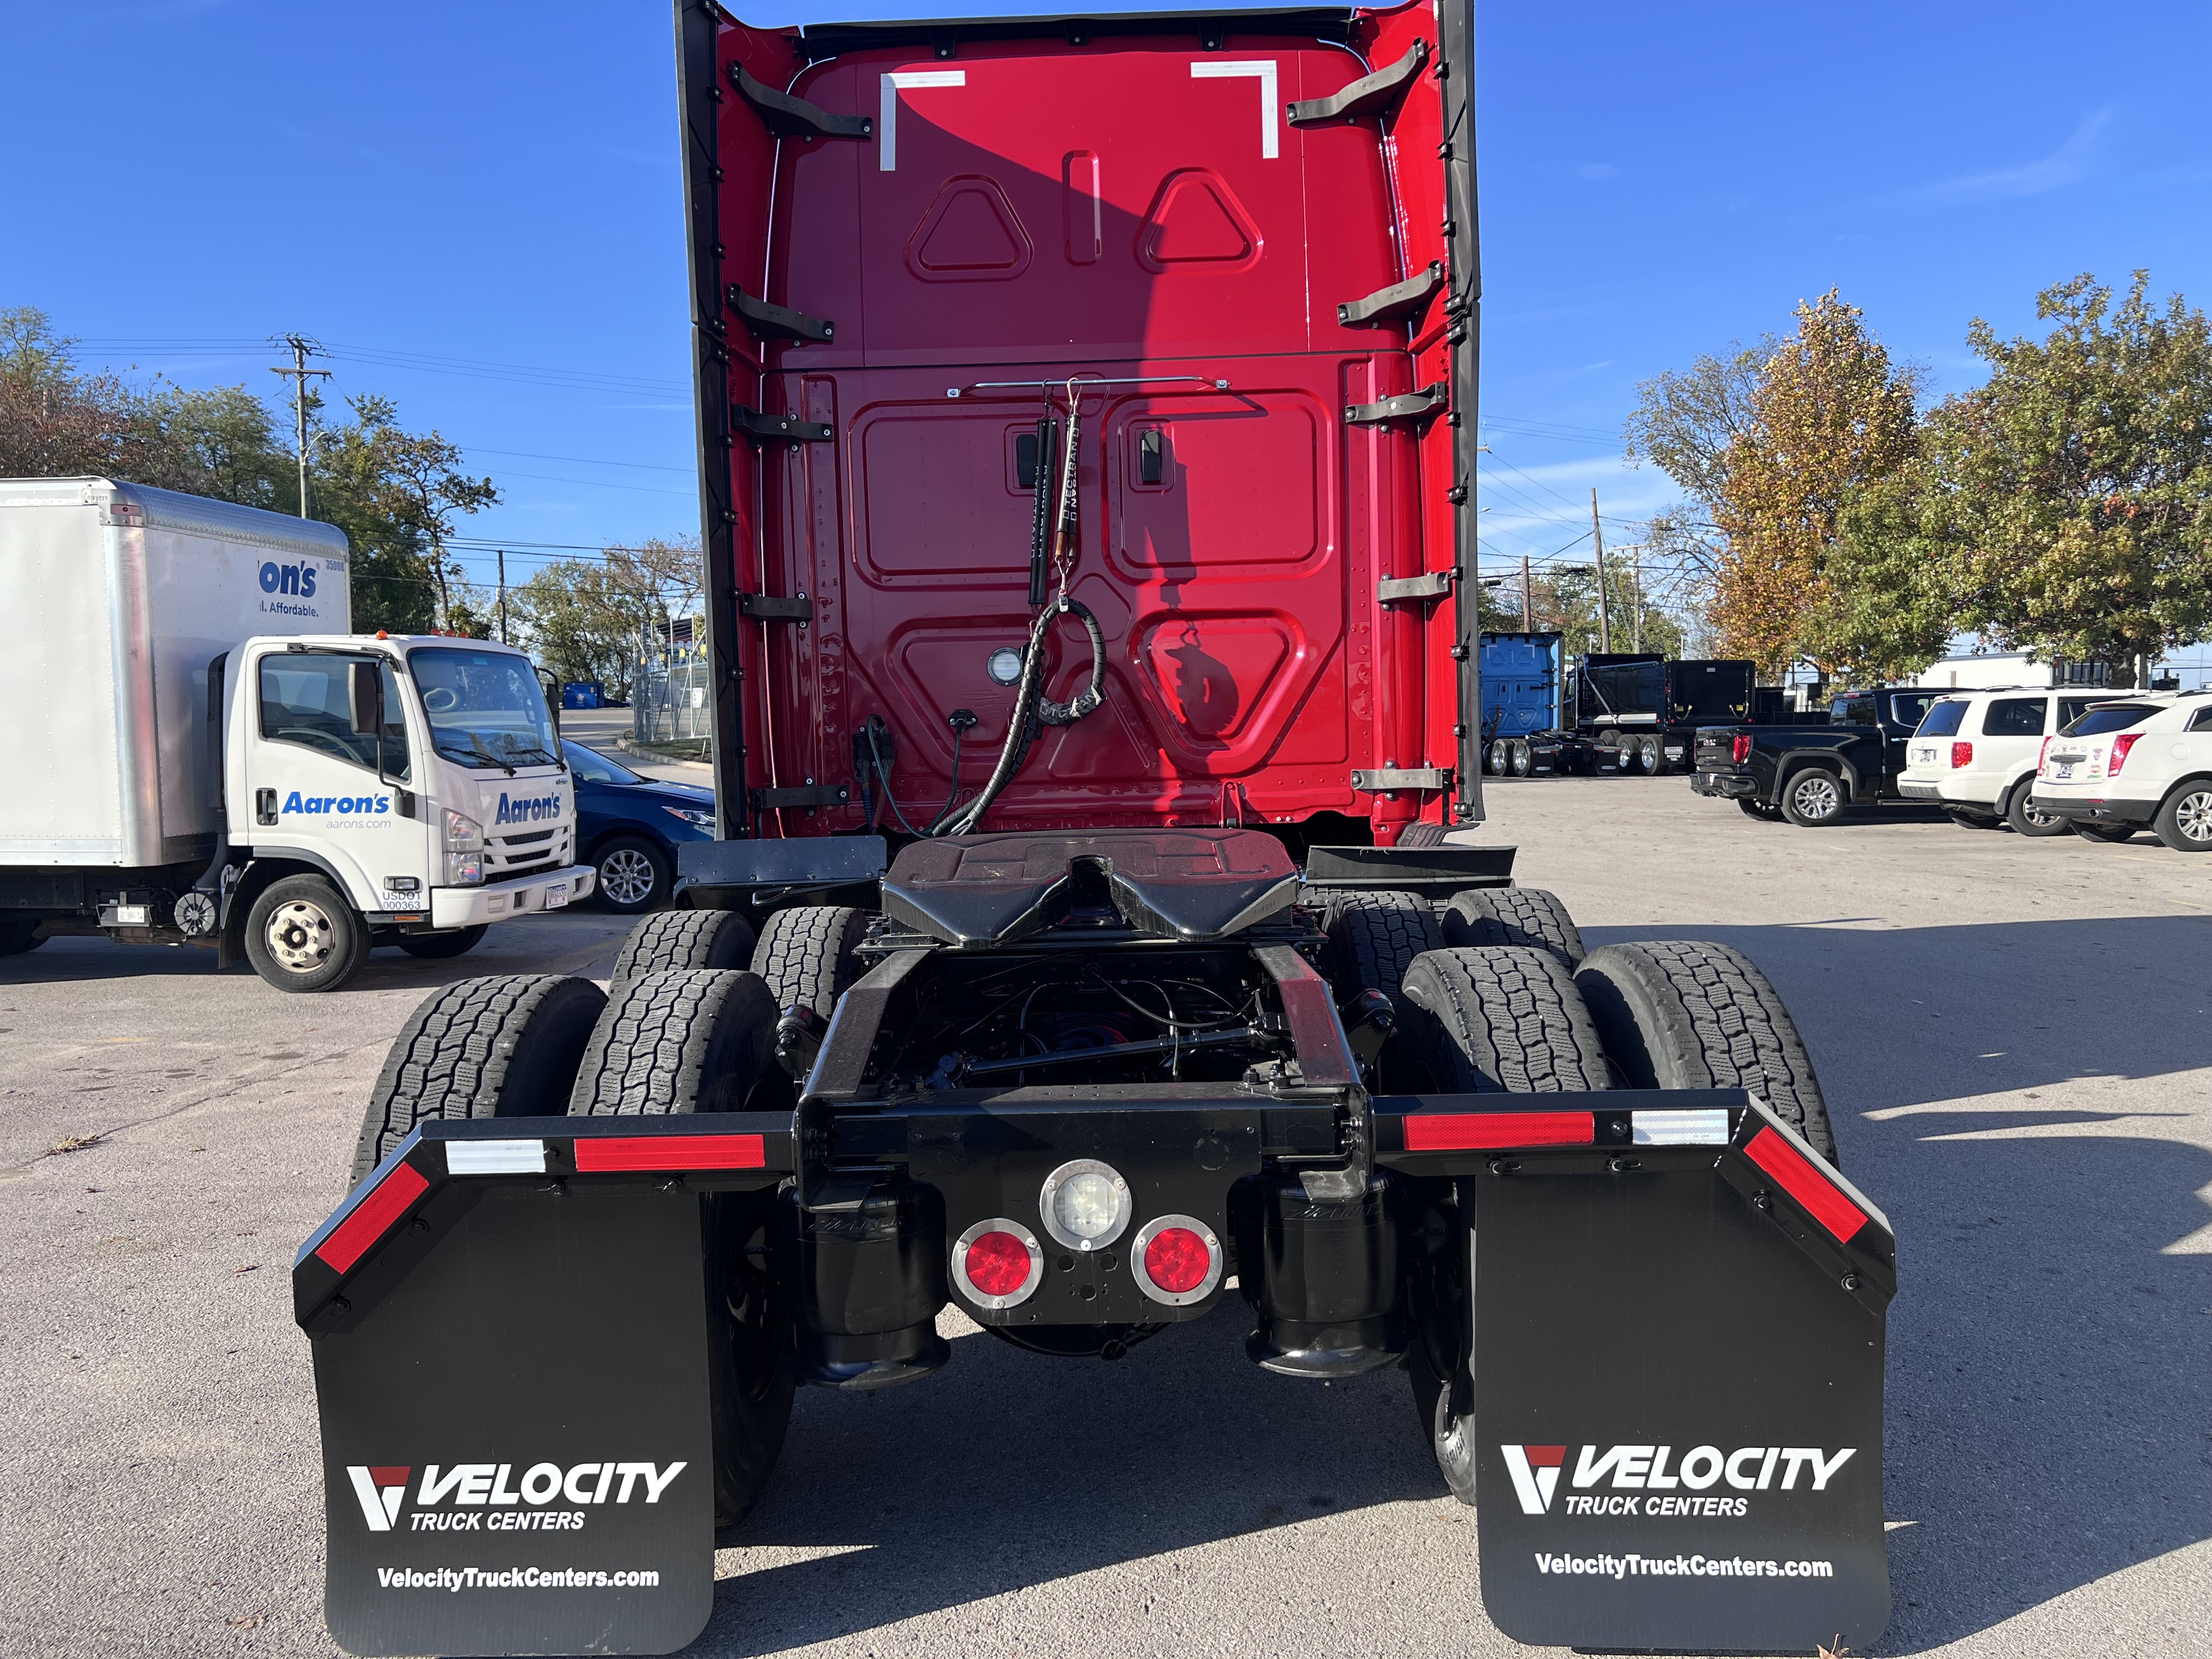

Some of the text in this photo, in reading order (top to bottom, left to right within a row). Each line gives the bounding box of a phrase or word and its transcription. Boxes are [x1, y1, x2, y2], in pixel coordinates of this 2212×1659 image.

[1064, 441, 1077, 506] TECTRAN
[258, 560, 317, 598] on's
[269, 602, 319, 617] Affordable.
[281, 791, 390, 814] Aaron's
[495, 792, 560, 826] Aaron's
[326, 820, 391, 829] aarons.com
[383, 891, 421, 900] USDOT
[383, 901, 421, 910] 000363
[1572, 1445, 1858, 1491] VELOCITY
[417, 1462, 688, 1505] VELOCITY
[1565, 1496, 1748, 1516] TRUCK CENTERS
[410, 1511, 585, 1531] TRUCK CENTERS
[1534, 1553, 1833, 1580] VelocityTruckCenters.com
[377, 1567, 659, 1593] VelocityTruckCenters.com
